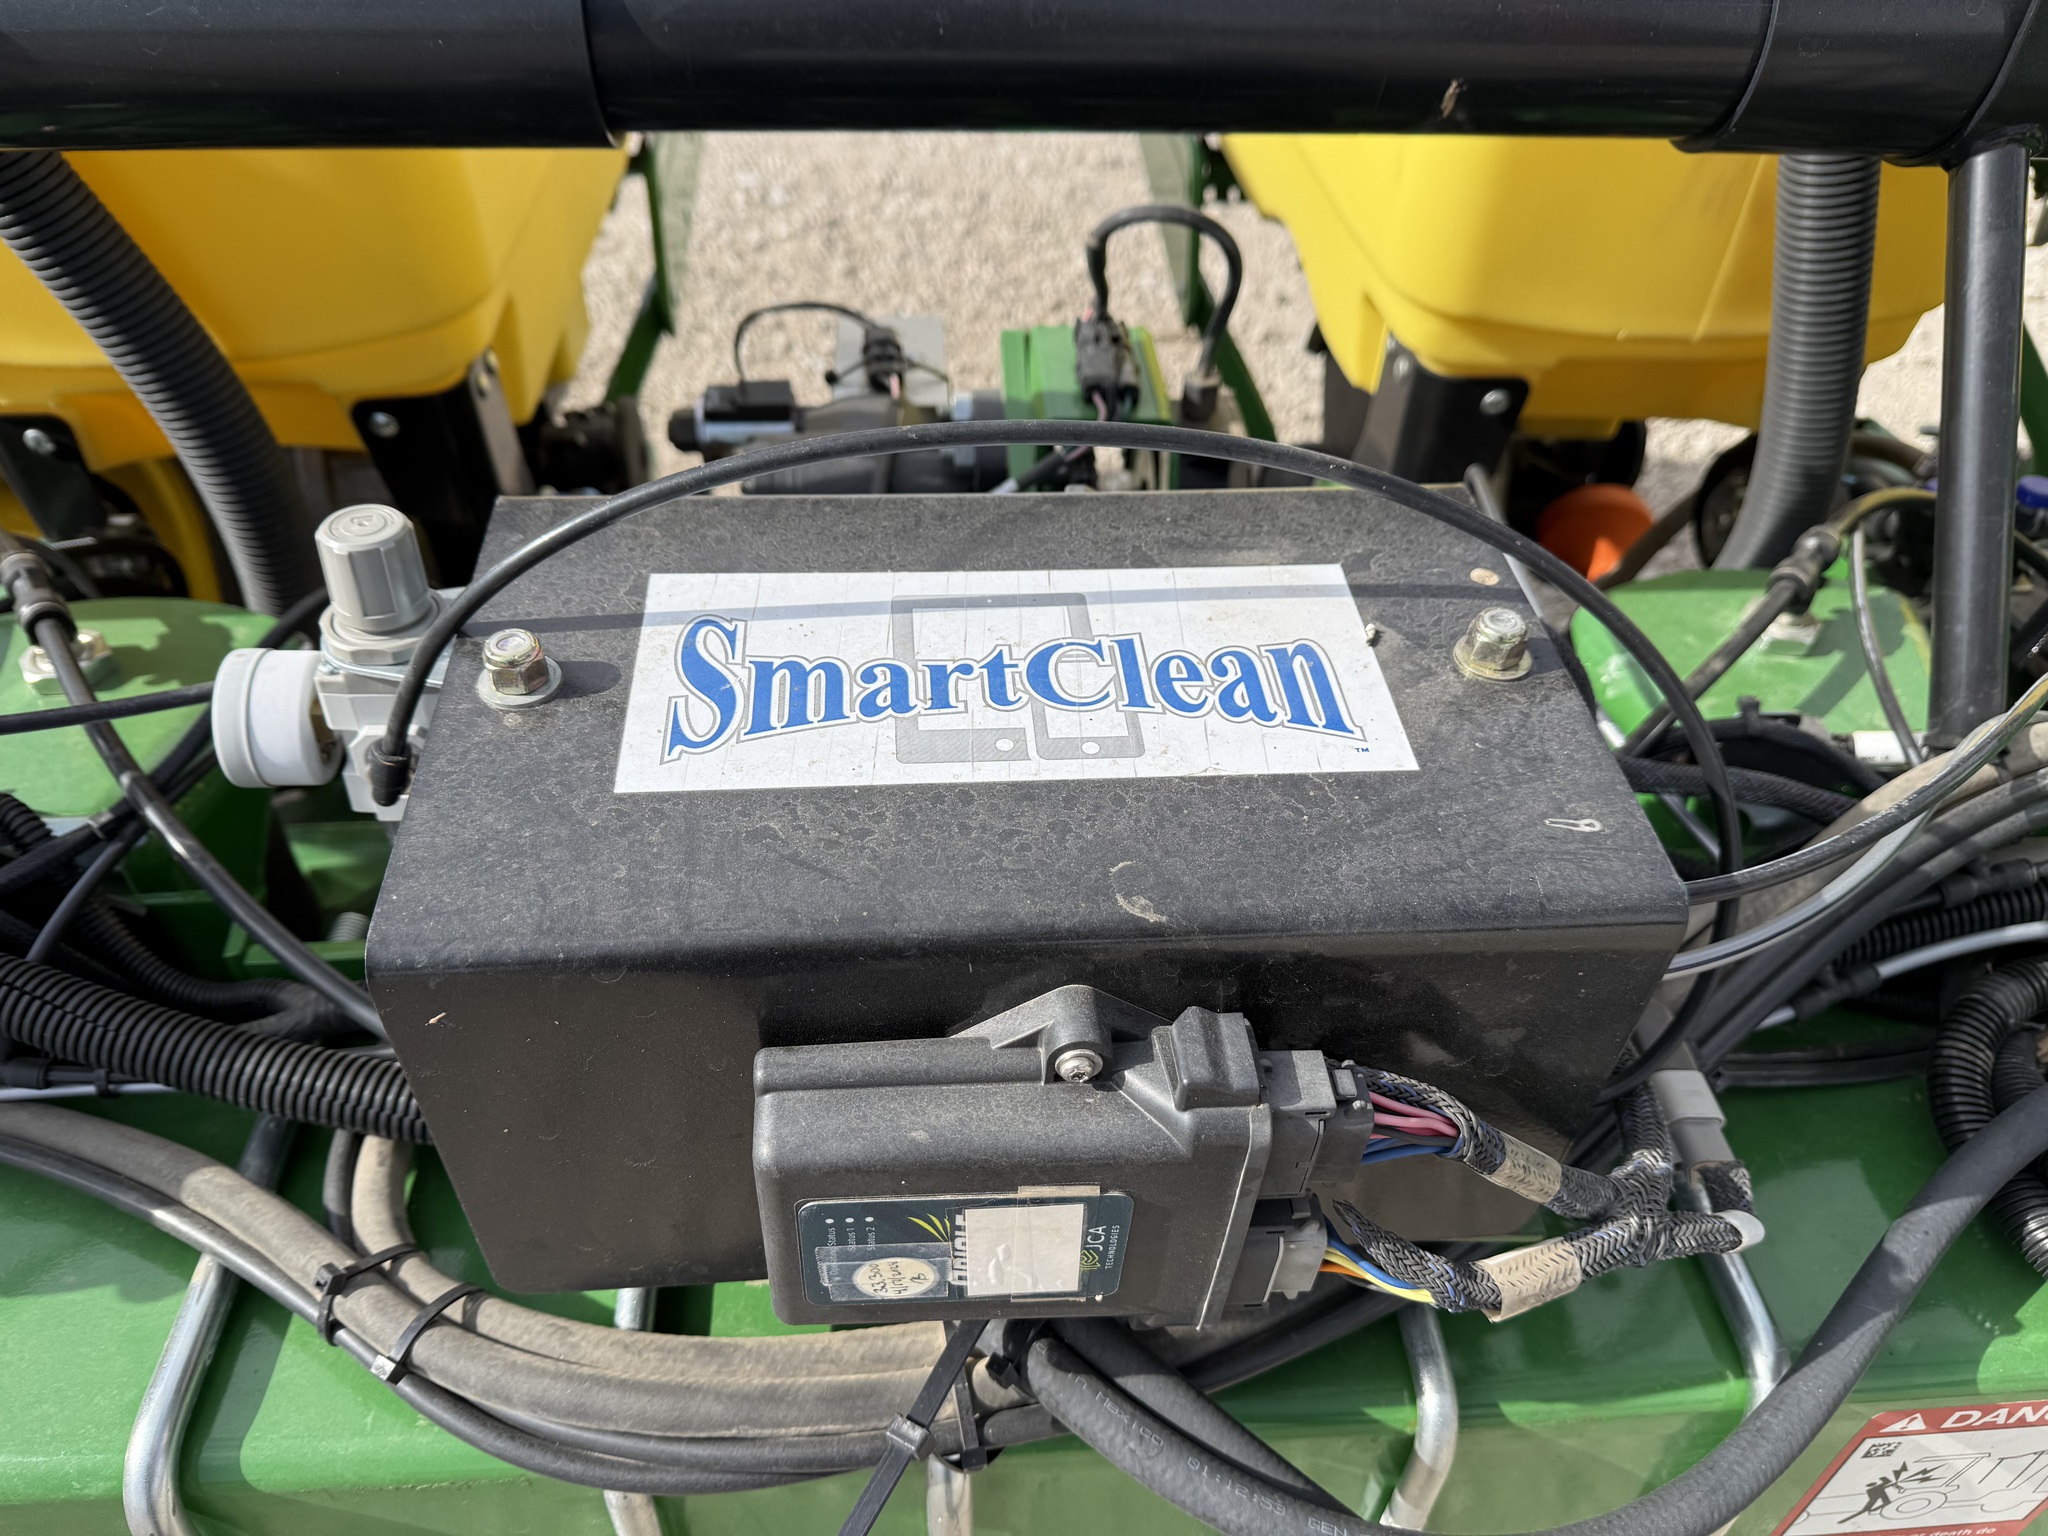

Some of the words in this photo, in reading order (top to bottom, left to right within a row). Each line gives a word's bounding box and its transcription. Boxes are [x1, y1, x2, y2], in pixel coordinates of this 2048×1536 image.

[662, 614, 1367, 765] SmartClean
[828, 1227, 836, 1246] Status
[847, 1232, 856, 1250] Status
[867, 1231, 876, 1250] Status
[1085, 1225, 1107, 1251] JCA
[1105, 1224, 1120, 1269] TECHNOLOGIES
[1095, 1391, 1163, 1446] Mexico
[1940, 1405, 2048, 1429] DAN
[1929, 1528, 1973, 1536] death
[1975, 1527, 1998, 1535] do
